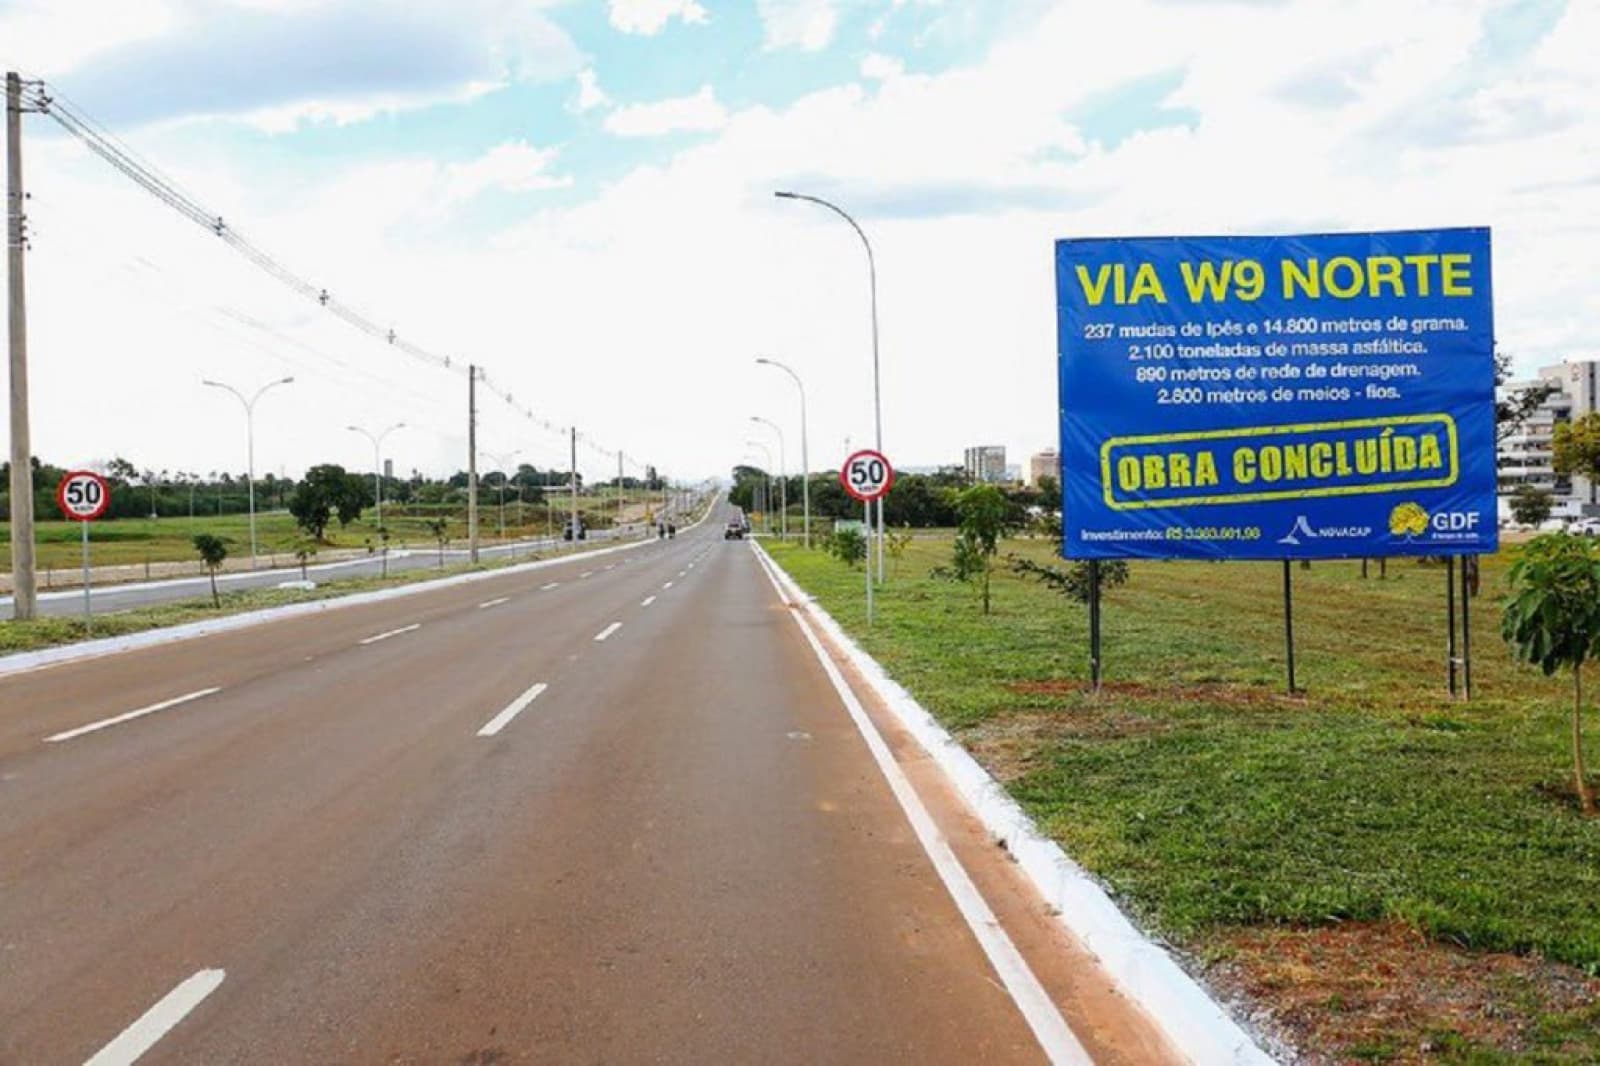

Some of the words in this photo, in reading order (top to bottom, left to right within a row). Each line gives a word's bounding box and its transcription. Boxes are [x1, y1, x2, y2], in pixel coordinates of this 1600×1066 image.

[1075, 262, 1167, 306] VIA
[1180, 259, 1266, 303] W9
[1281, 253, 1475, 300] NORTE
[1084, 323, 1115, 340] 237
[1119, 322, 1176, 338] mudas
[1180, 321, 1202, 337] de
[1247, 322, 1259, 336] e
[1263, 317, 1318, 335] 14.800
[1321, 318, 1383, 334] metros
[1386, 316, 1409, 332] de
[1411, 317, 1469, 335] grama.
[1128, 344, 1175, 362] 2.100
[1178, 342, 1262, 360] toneladas
[1265, 341, 1288, 358] de
[1291, 342, 1349, 357] massa
[1136, 366, 1167, 383] 890
[1171, 366, 1232, 382] metros
[1234, 365, 1258, 381] de
[1261, 364, 1300, 380] rede
[1305, 362, 1328, 379] de
[1330, 362, 1422, 381] drenagem.
[1206, 387, 1268, 403] metros
[1271, 386, 1294, 402] de
[1297, 385, 1350, 401] meios
[1366, 382, 1401, 400] fios.
[1117, 451, 1219, 493] OBRA
[1232, 426, 1443, 484] CONCLUÍDA
[851, 459, 883, 485] 50
[67, 480, 101, 505] 50
[1318, 526, 1373, 538] NOVACAP
[1432, 512, 1480, 531] GDF
